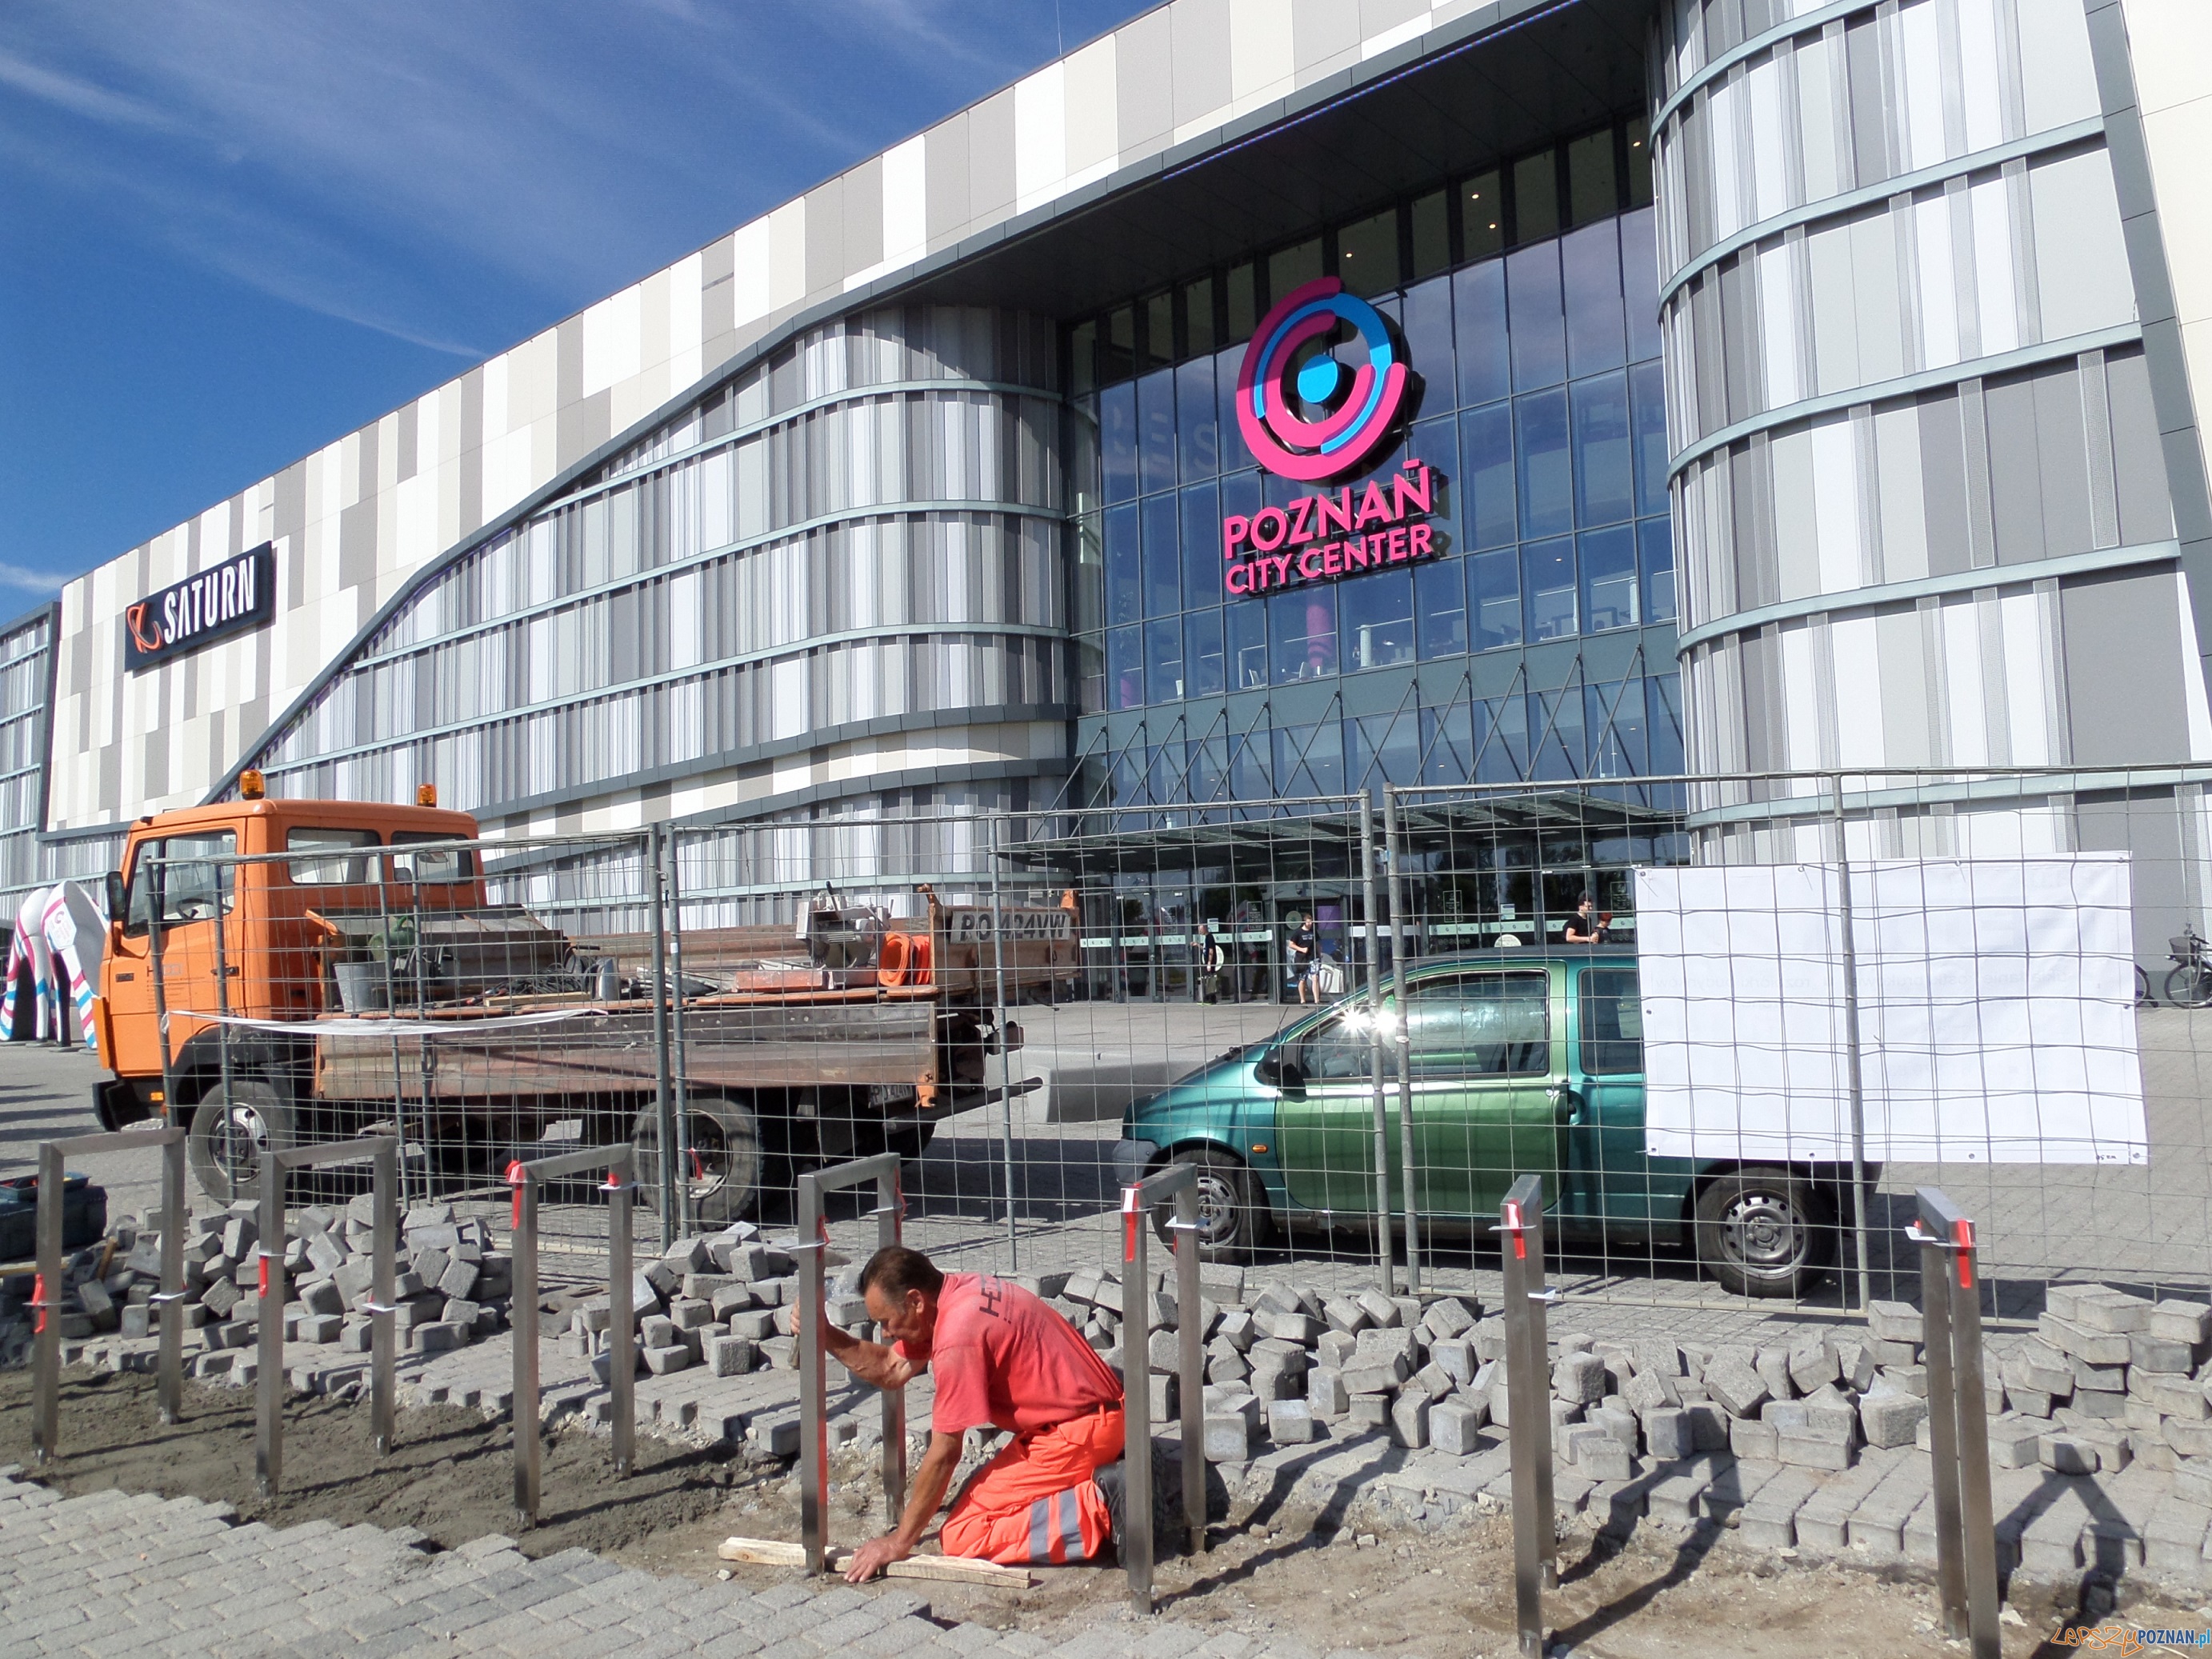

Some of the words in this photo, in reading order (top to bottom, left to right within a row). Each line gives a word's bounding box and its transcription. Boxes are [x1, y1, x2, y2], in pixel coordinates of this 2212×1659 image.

[1224, 458, 1432, 559] POZNAŃ
[164, 555, 255, 645] SATURN
[1226, 553, 1293, 594] CITY
[1300, 524, 1434, 578] CENTER
